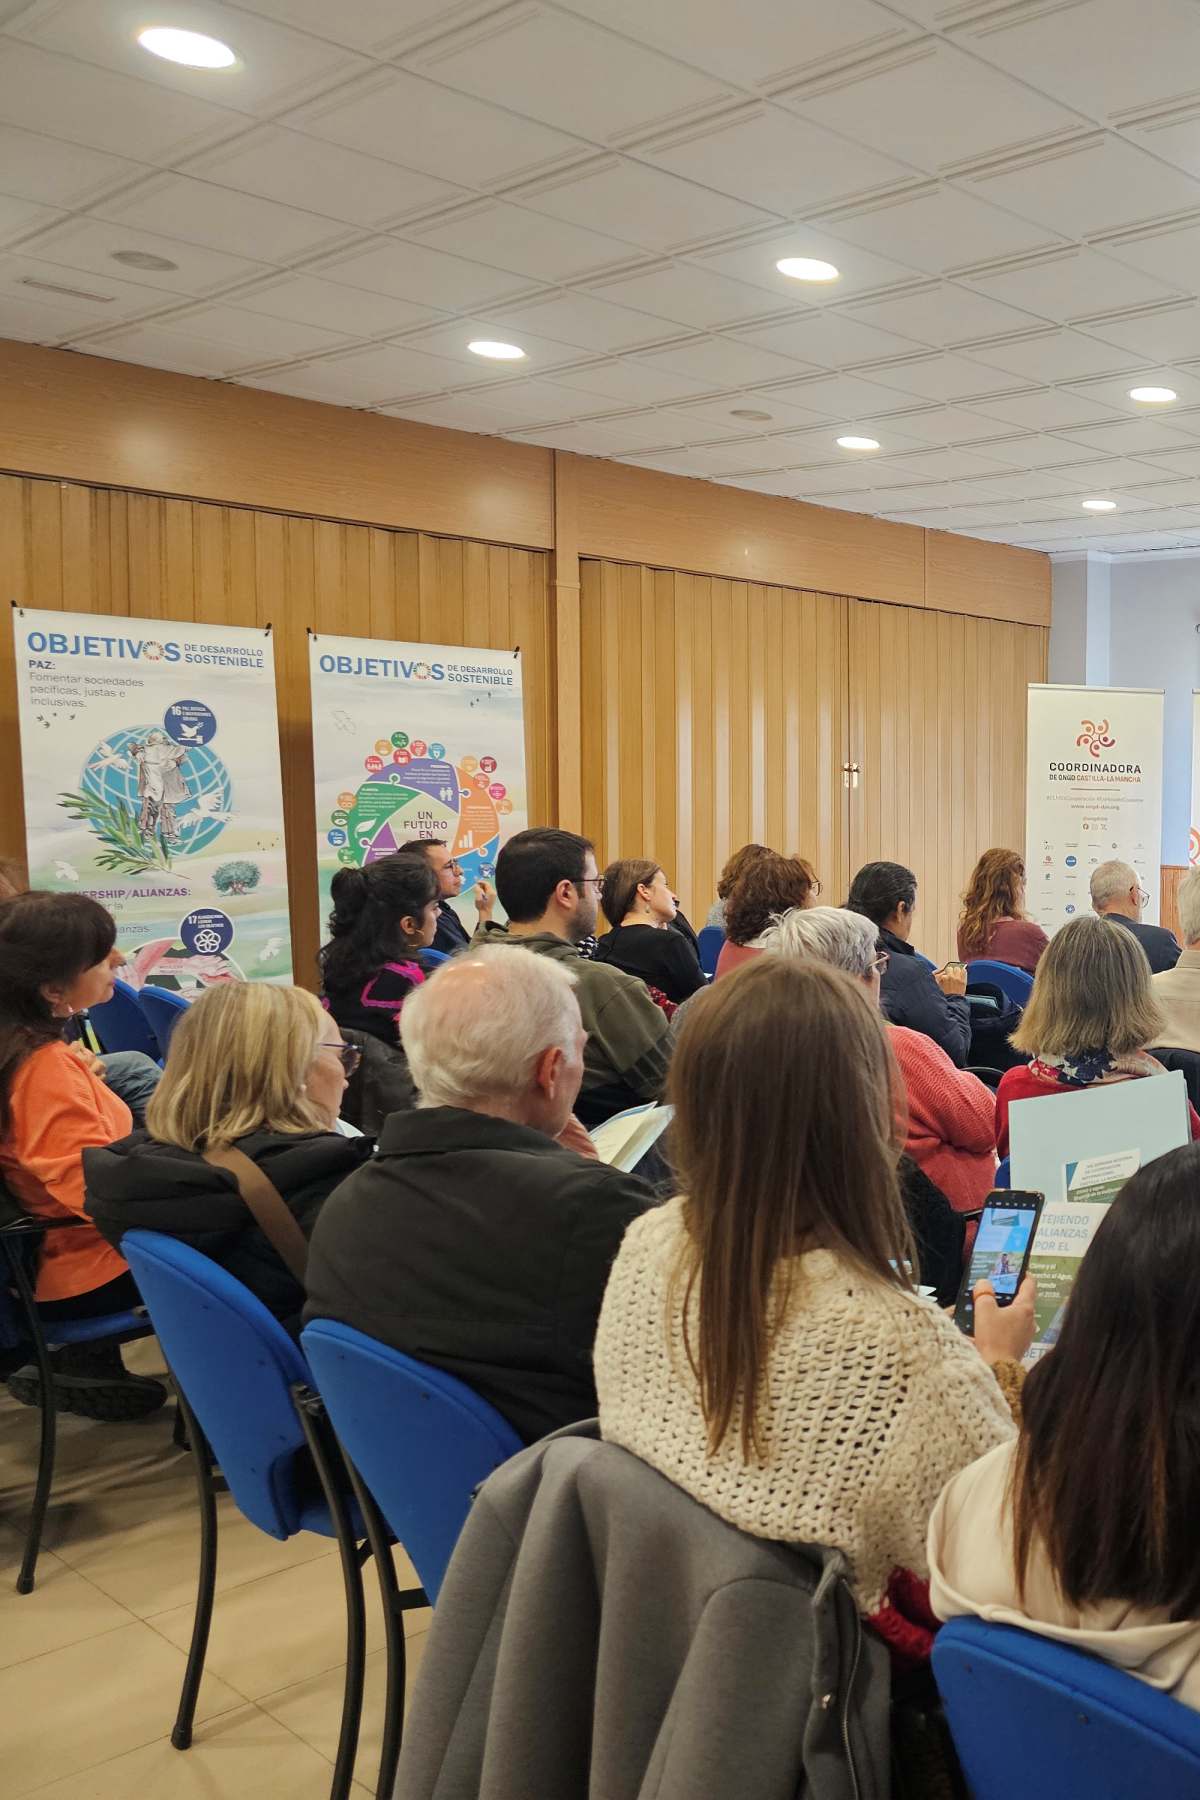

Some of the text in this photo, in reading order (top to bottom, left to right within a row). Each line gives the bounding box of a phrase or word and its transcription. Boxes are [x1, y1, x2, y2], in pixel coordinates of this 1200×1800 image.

[28, 632, 181, 662] OBJETIVOS
[184, 644, 263, 657] DE DESARROLLO
[29, 659, 56, 670] PAZ:
[185, 653, 264, 668] SOSTENIBLE
[319, 655, 445, 681] OBJETIVOS
[447, 664, 513, 676] DE DESARROLLO
[29, 671, 145, 687] Fomentar sociedades
[448, 673, 513, 686] SOSTENIBLE
[84, 687, 117, 698] justas
[171, 706, 182, 716] 16
[1049, 762, 1142, 774] COORDINADORA
[1077, 774, 1114, 783] CASTILLA-LA
[417, 811, 433, 820] UN
[403, 821, 448, 830] FUTURO
[419, 830, 433, 839] EN
[188, 915, 198, 924] 17
[1041, 1214, 1090, 1226] TEJIENDO
[1037, 1227, 1089, 1239] ALIANZAS
[1034, 1240, 1071, 1251] POR EL
